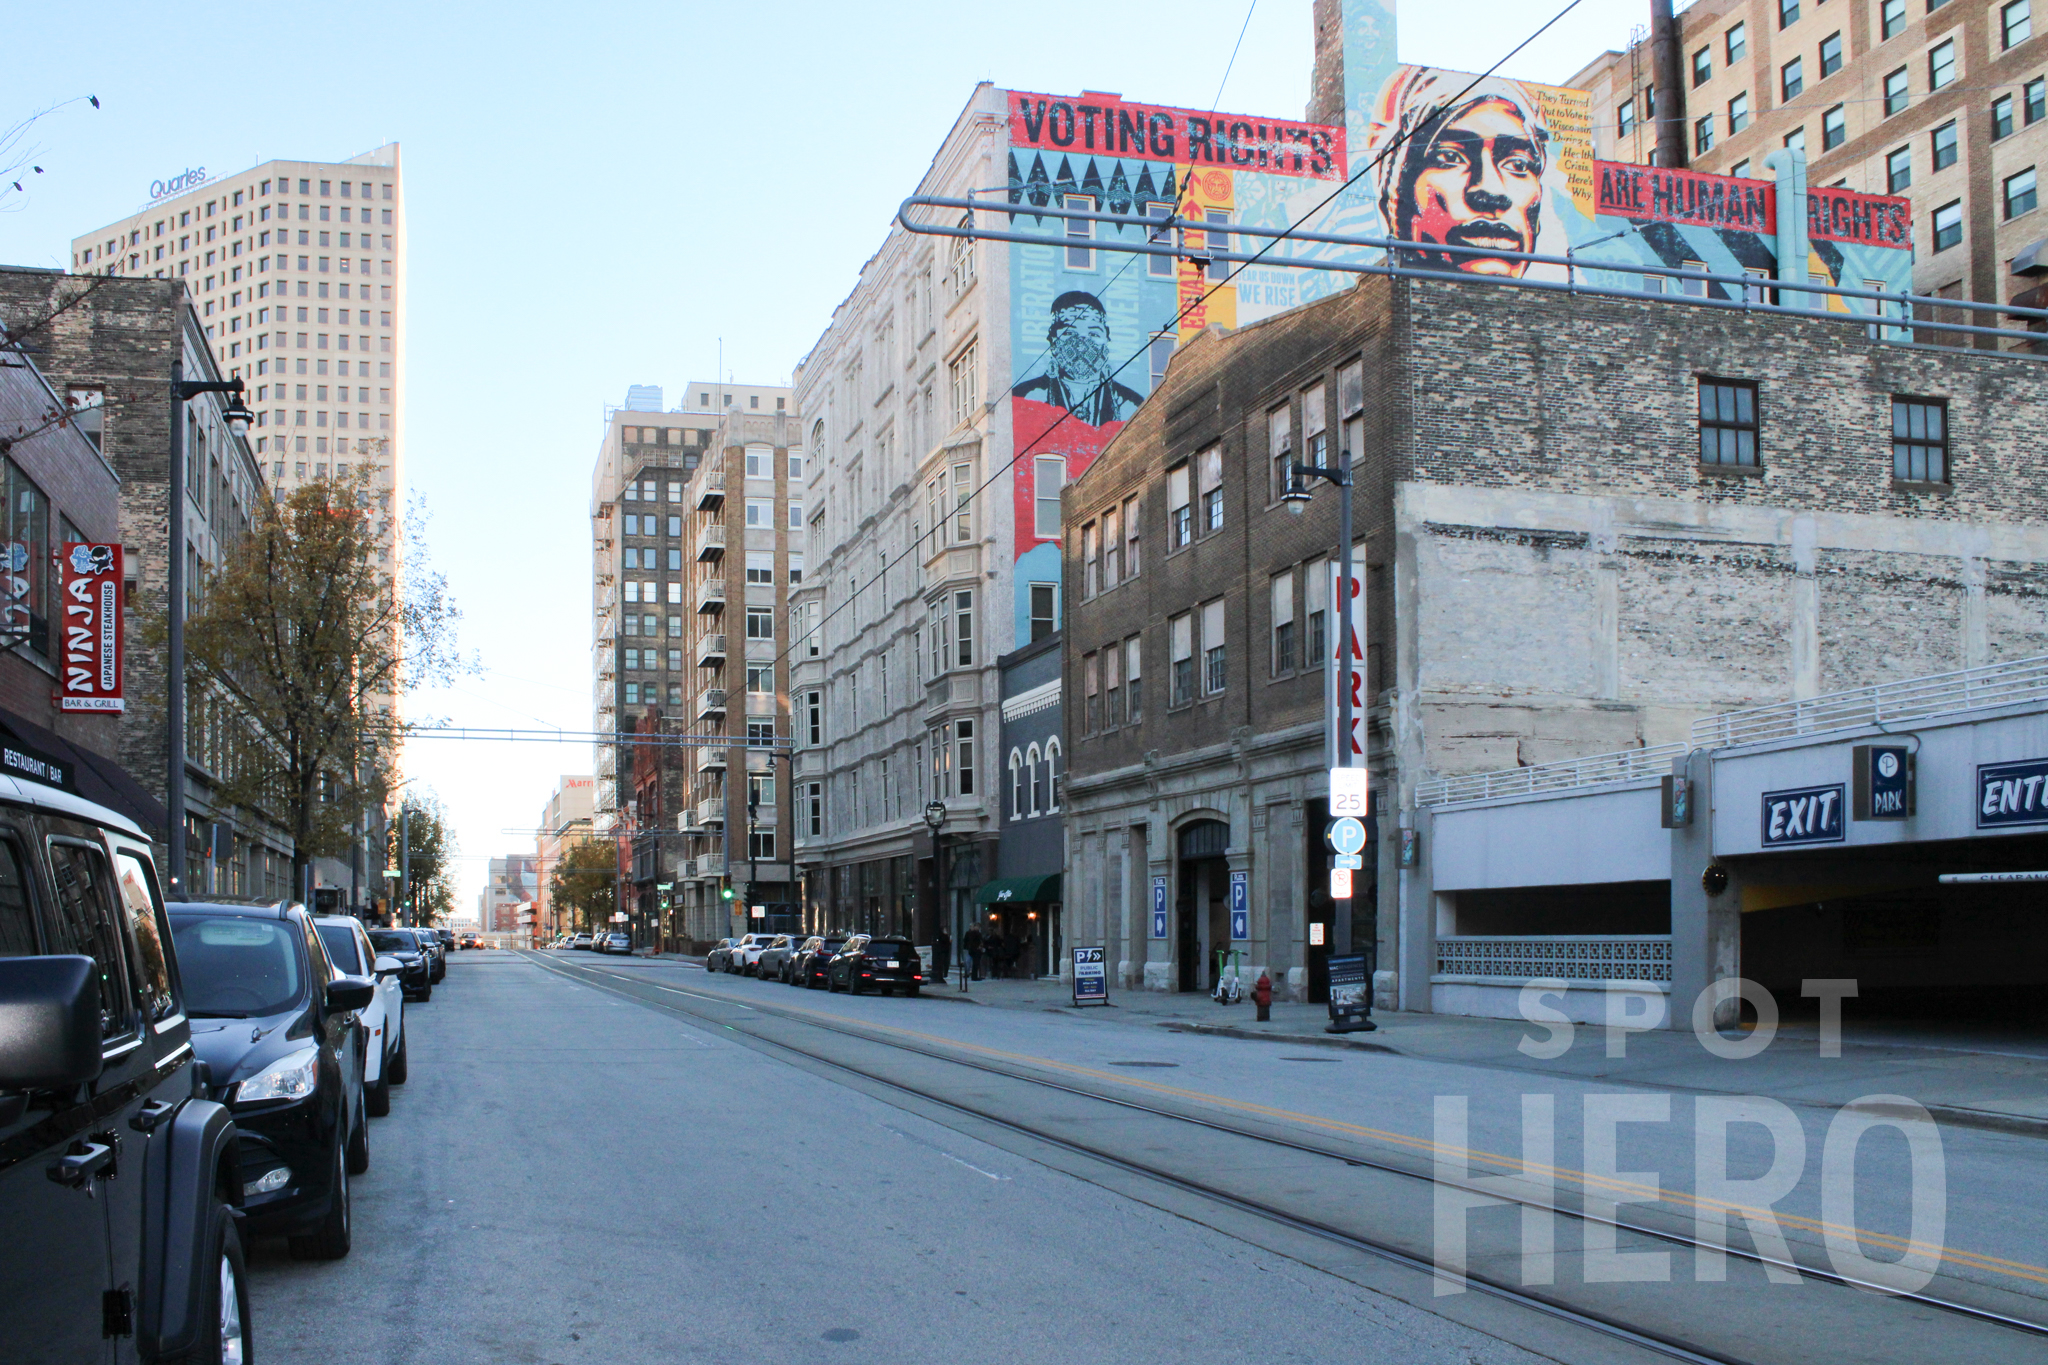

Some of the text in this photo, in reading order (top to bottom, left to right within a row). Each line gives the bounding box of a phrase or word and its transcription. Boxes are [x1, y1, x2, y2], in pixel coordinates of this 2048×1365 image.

[1537, 90, 1558, 104] They
[1557, 107, 1565, 117] to
[1565, 108, 1583, 120] Vote
[1020, 98, 1333, 175] VOTING RIGHTS
[150, 166, 206, 199] Quarles
[1567, 172, 1594, 186] Here's
[1572, 186, 1593, 201] Why.
[1600, 167, 1907, 244] ARE HUMAN RIGHTS
[1259, 270, 1270, 283] US
[1271, 271, 1296, 285] DOWN
[1238, 283, 1296, 307] WE RISE
[67, 578, 94, 693] NINJA
[103, 584, 113, 687] JAPANESE STEAKHOUSE
[1335, 575, 1363, 755] PARK
[64, 699, 119, 709] BAR & GRILL
[4, 747, 46, 777] RESTAURANT
[50, 765, 62, 784] BAR
[1882, 755, 1895, 774] P
[1336, 793, 1361, 810] 25
[1875, 789, 1903, 815] PARK
[1768, 790, 1839, 841] EXIT
[1342, 826, 1358, 848] P
[1156, 888, 1163, 909] P
[1236, 885, 1243, 908] P
[1076, 951, 1086, 963] P
